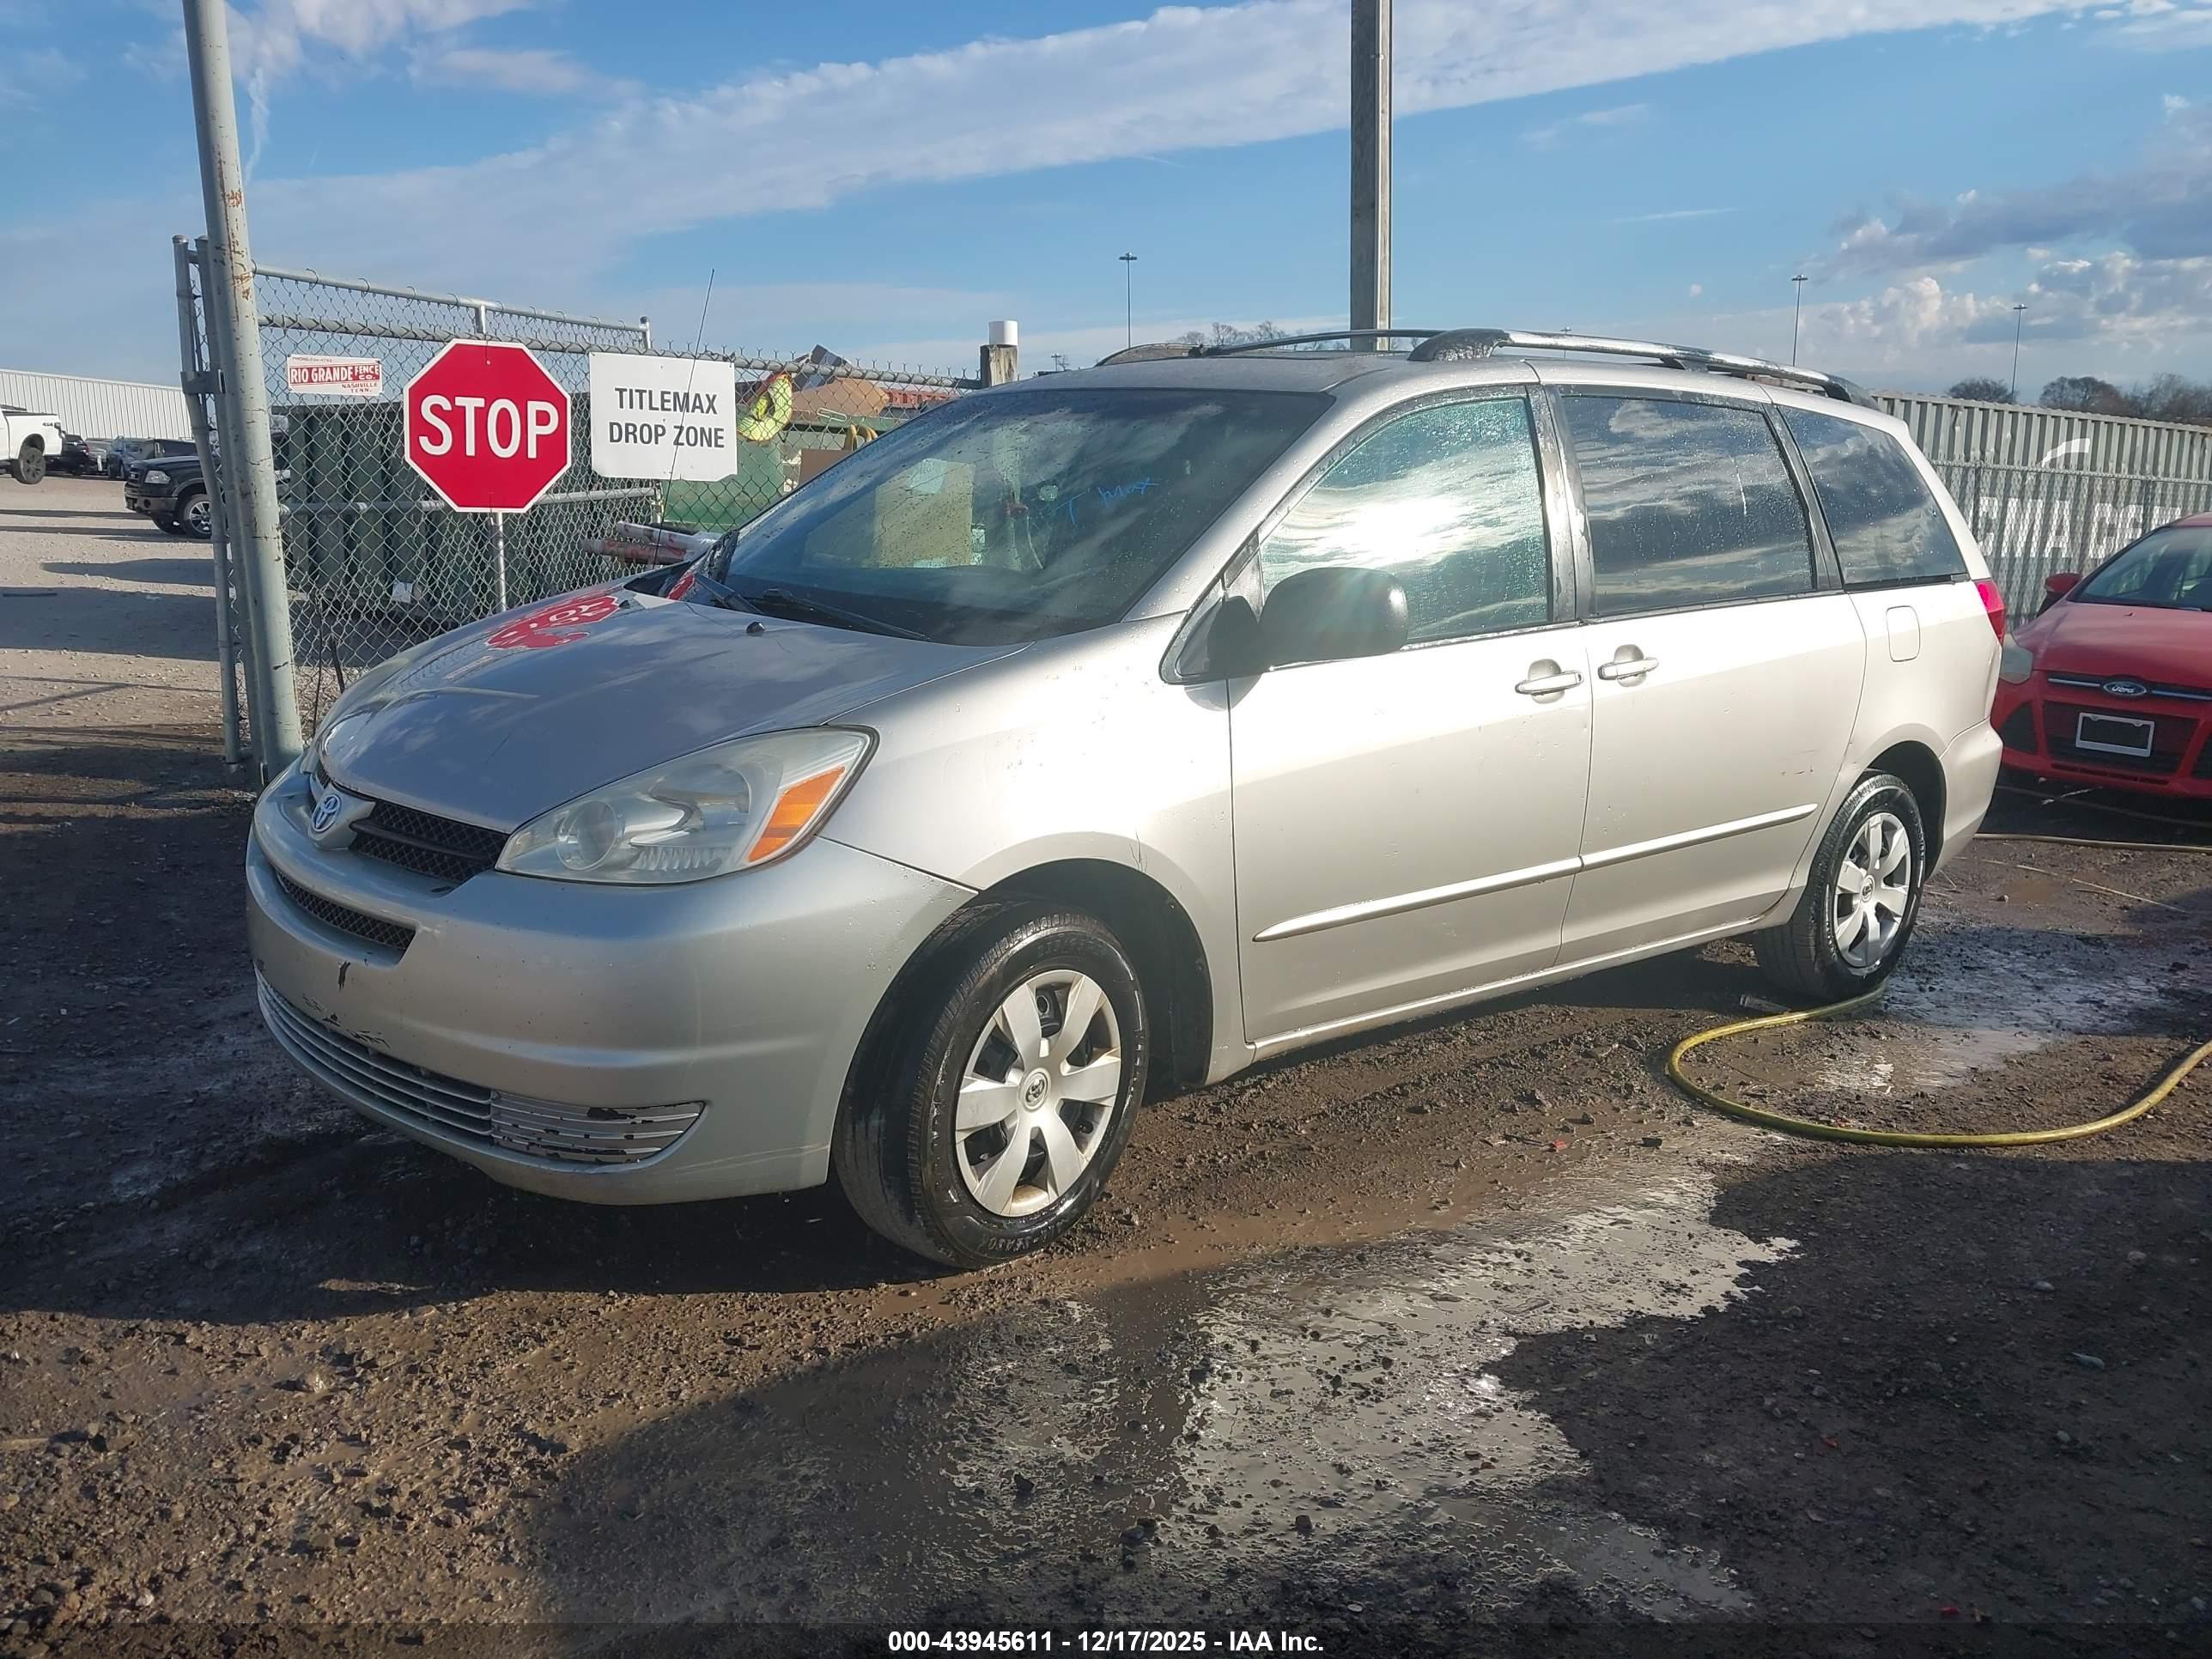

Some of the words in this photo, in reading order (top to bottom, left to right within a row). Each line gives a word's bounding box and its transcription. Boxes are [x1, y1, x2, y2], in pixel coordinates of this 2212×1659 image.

[290, 368, 309, 383] RIO
[311, 366, 354, 382] GRANDE
[355, 365, 380, 376] FENCE
[615, 387, 718, 415] TITLEMAX
[418, 394, 559, 459] STOP
[609, 422, 666, 445] DROP
[672, 425, 726, 448] ZONE
